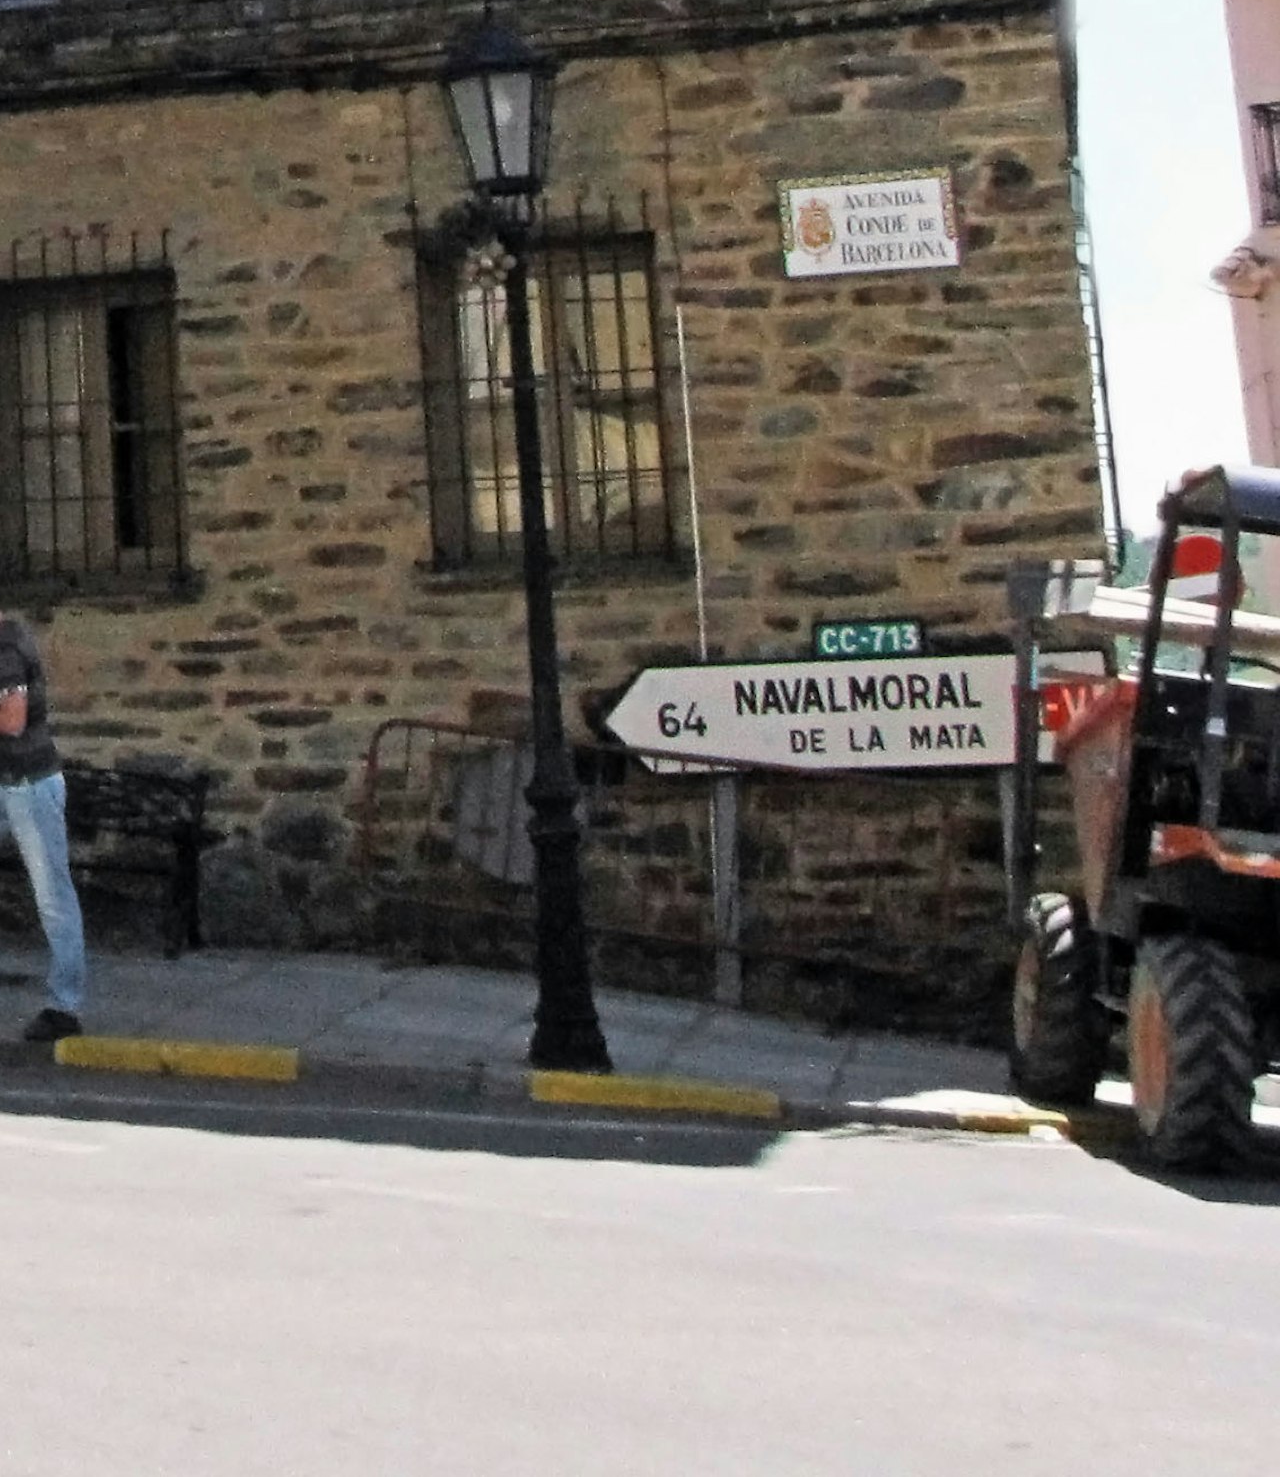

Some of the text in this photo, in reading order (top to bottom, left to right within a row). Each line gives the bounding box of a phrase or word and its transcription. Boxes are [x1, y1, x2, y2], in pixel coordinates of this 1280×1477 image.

[843, 190, 926, 210] AVENIDA
[847, 214, 908, 236] CONDE
[841, 240, 948, 265] BARCELONA
[820, 624, 920, 654] CC-713
[734, 672, 983, 715] NAVALMORAL
[657, 702, 708, 738] 64
[790, 723, 987, 754] DE LA MATA
